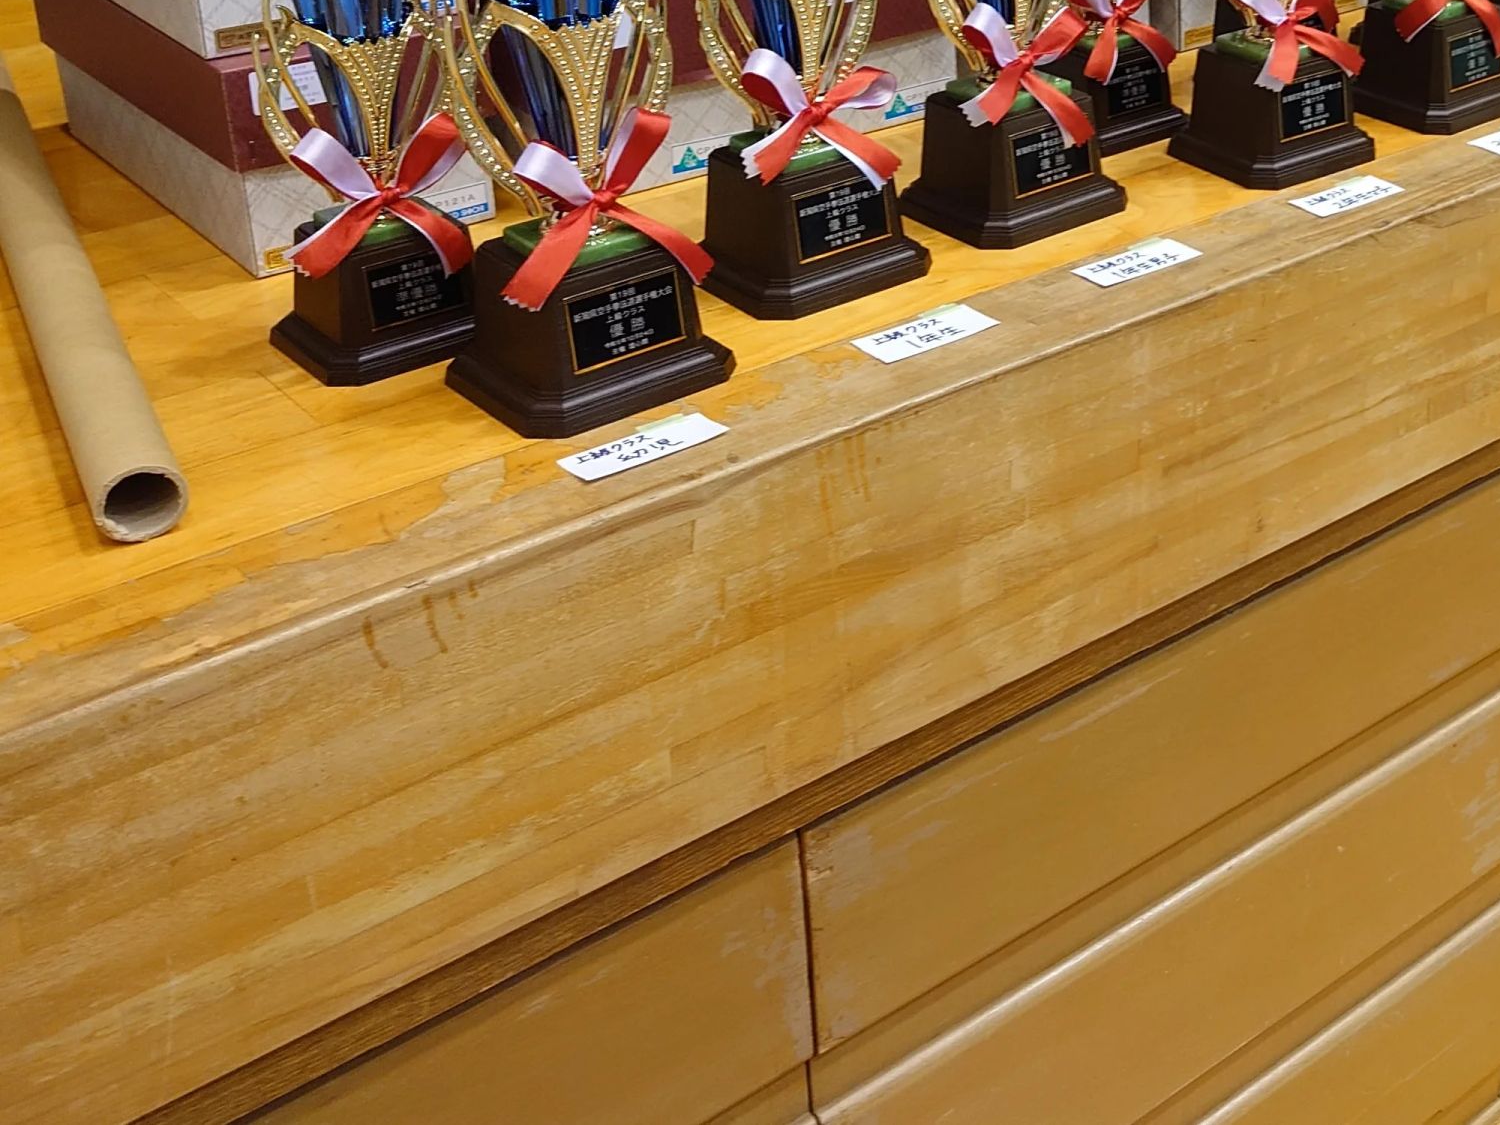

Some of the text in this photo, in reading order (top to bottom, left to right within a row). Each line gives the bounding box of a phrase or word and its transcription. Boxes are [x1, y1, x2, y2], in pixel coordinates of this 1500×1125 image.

[828, 213, 859, 232] 優勝
[605, 305, 646, 324] 上級クラス
[609, 316, 646, 339] 優勝
[905, 325, 966, 349] 1年生
[617, 438, 684, 463] 幼児
